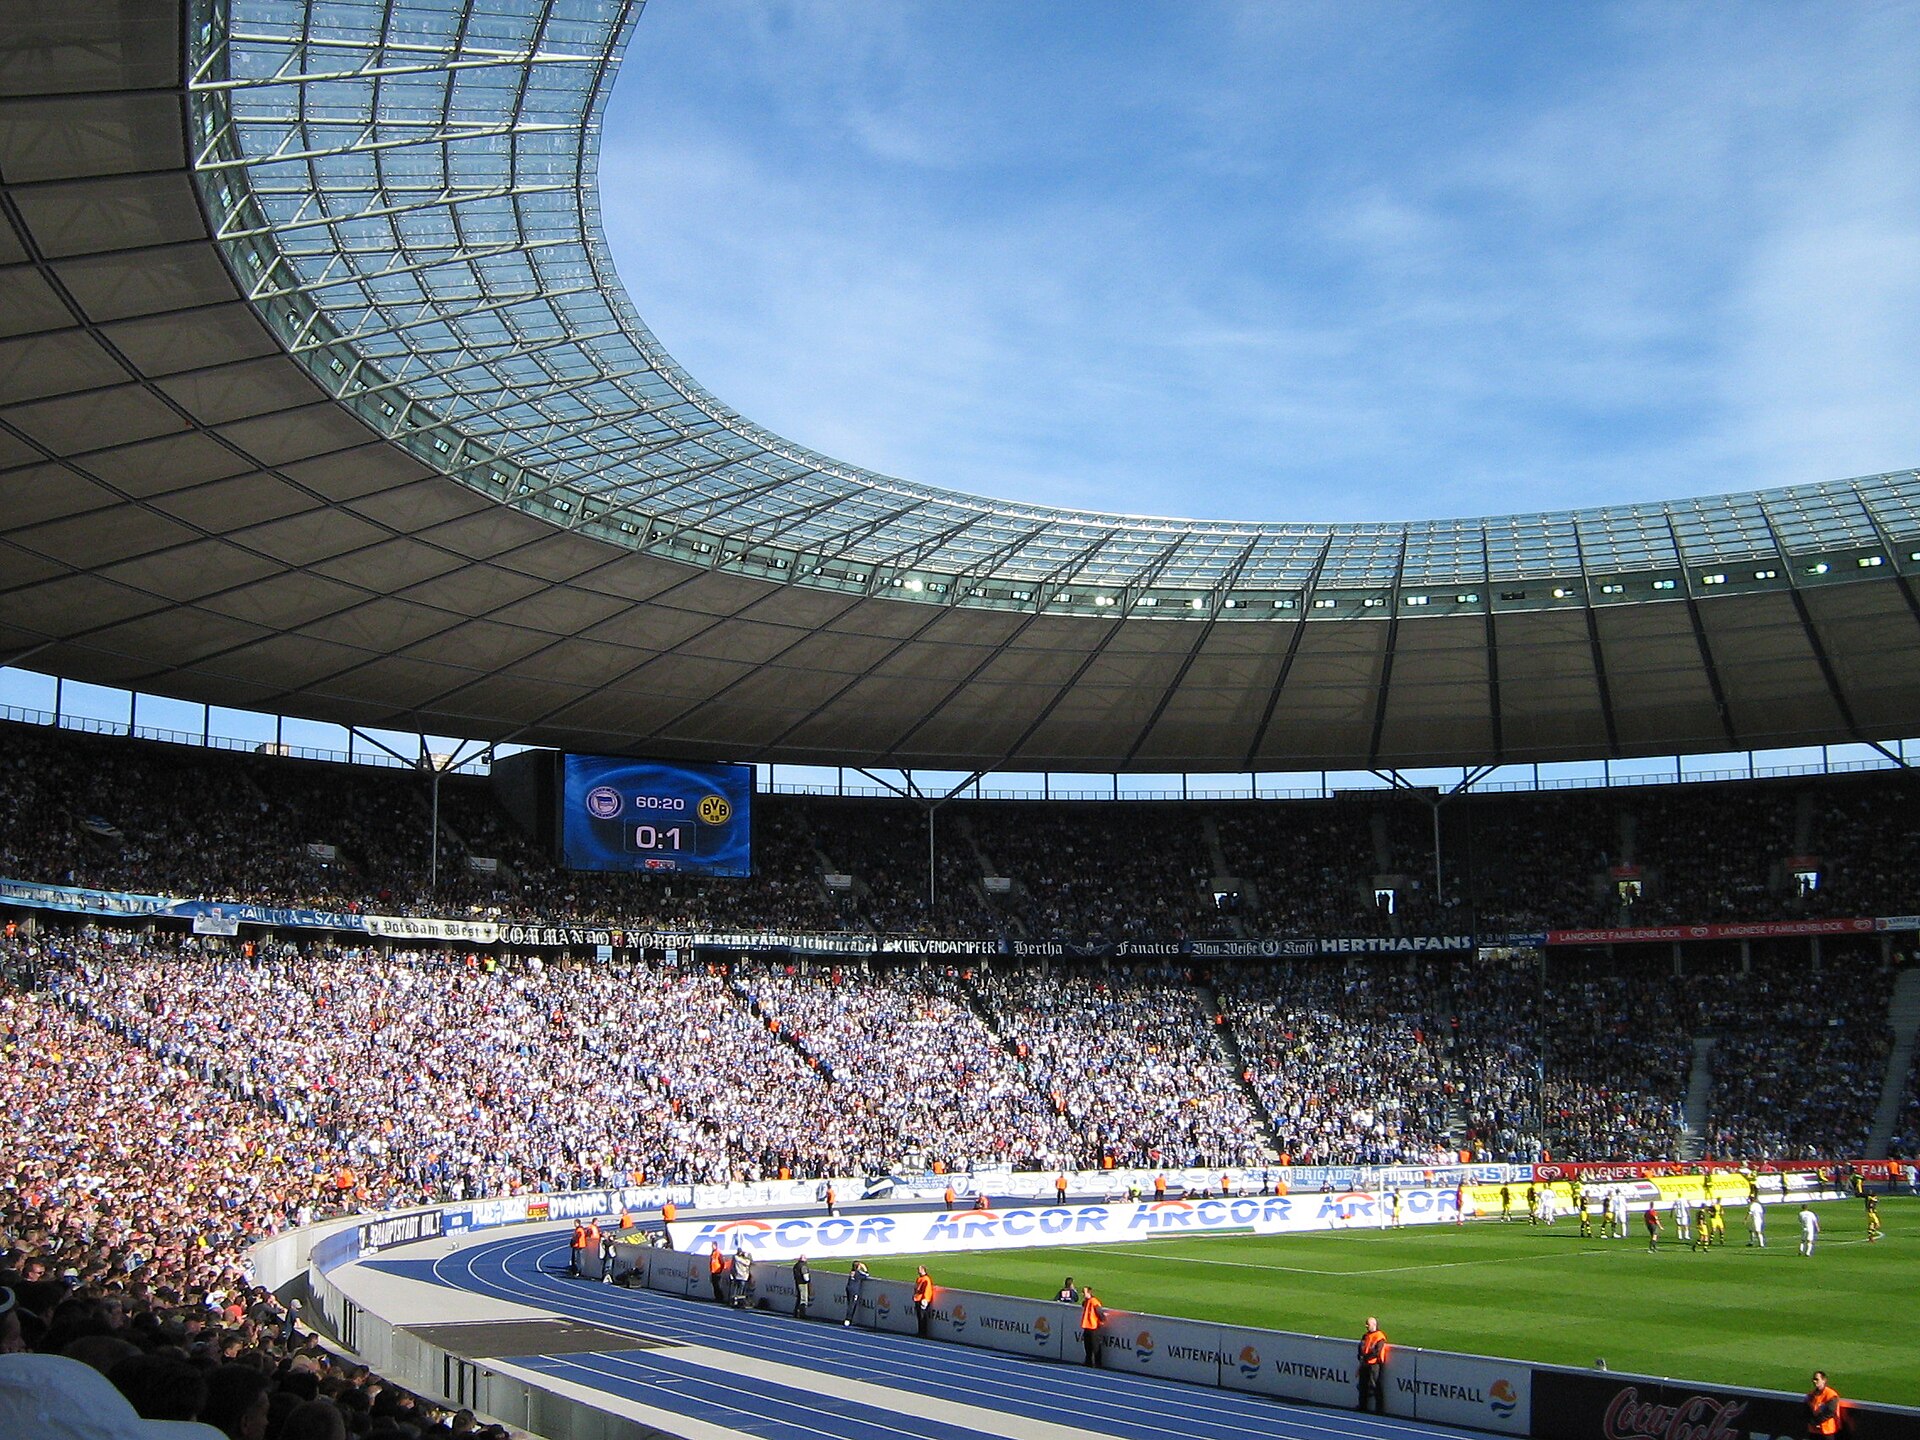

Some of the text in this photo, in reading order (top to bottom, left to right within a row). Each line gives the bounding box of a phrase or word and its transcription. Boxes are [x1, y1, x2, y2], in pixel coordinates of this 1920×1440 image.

[635, 796, 685, 811] 60:20
[702, 799, 727, 816] BVB
[635, 825, 680, 851] 0:1
[314, 912, 361, 928] SZENE
[383, 911, 481, 938] Potsdam West
[1718, 921, 1843, 936] LANGNESE FAMILIENBLOCK
[499, 925, 609, 945] COMMANDO
[625, 931, 678, 951] NORD
[1321, 936, 1471, 953] HERTHAFANS
[1559, 931, 1606, 941] LANGNESE
[1608, 928, 1680, 940] FAMILIENBLOCK
[894, 940, 996, 954] KURVENDAMPFER
[1013, 940, 1180, 957] Hertha Fanatics
[1295, 1169, 1350, 1181] BRIGADE
[549, 1193, 607, 1220] DYNAMIC
[1128, 1198, 1292, 1229] ARCOR
[923, 1203, 1106, 1242] ARCOR
[685, 1219, 895, 1252] ARCOR
[979, 1316, 1031, 1335] VATTENFALL
[1167, 1344, 1236, 1367] VATTENFALL
[1275, 1360, 1350, 1384] VATTENFALL
[1396, 1377, 1484, 1404] VATTENFALL
